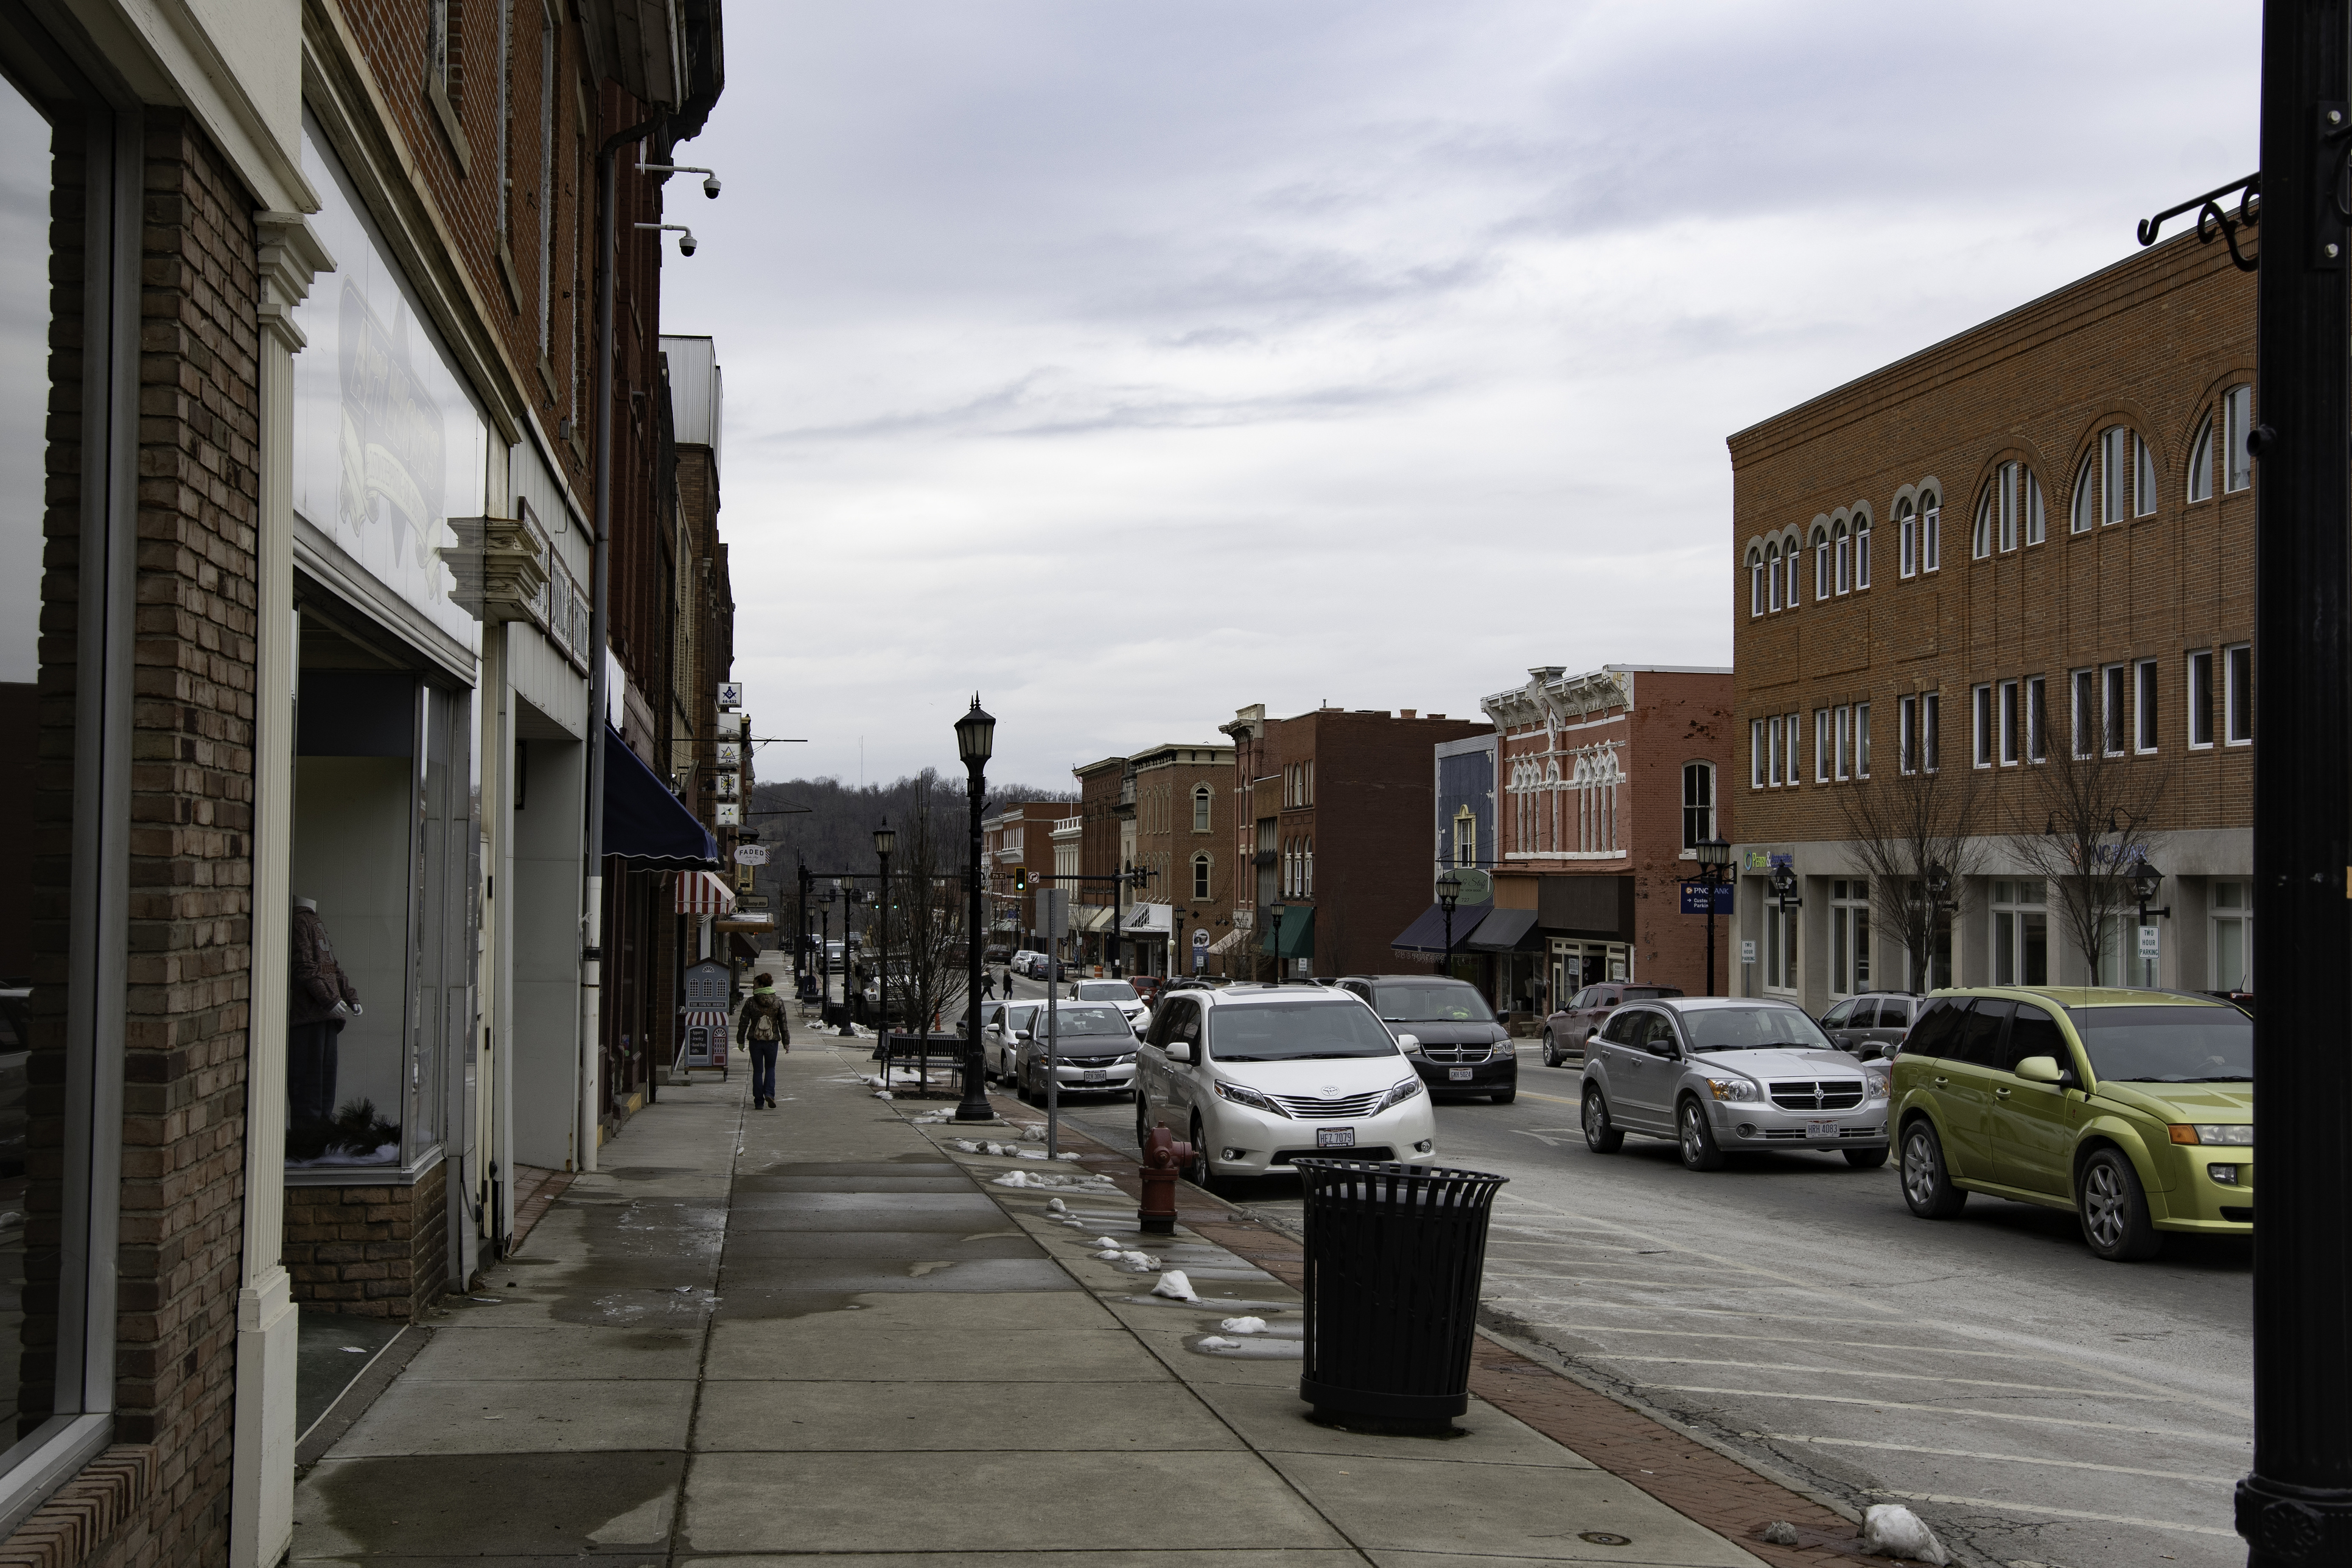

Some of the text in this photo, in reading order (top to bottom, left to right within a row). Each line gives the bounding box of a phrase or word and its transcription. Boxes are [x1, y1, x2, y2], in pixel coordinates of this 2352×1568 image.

[1469, 877, 1487, 889] Stuff
[1808, 1124, 1837, 1133] HRH 4083
[1320, 1133, 1351, 1143] HEZ 7079
